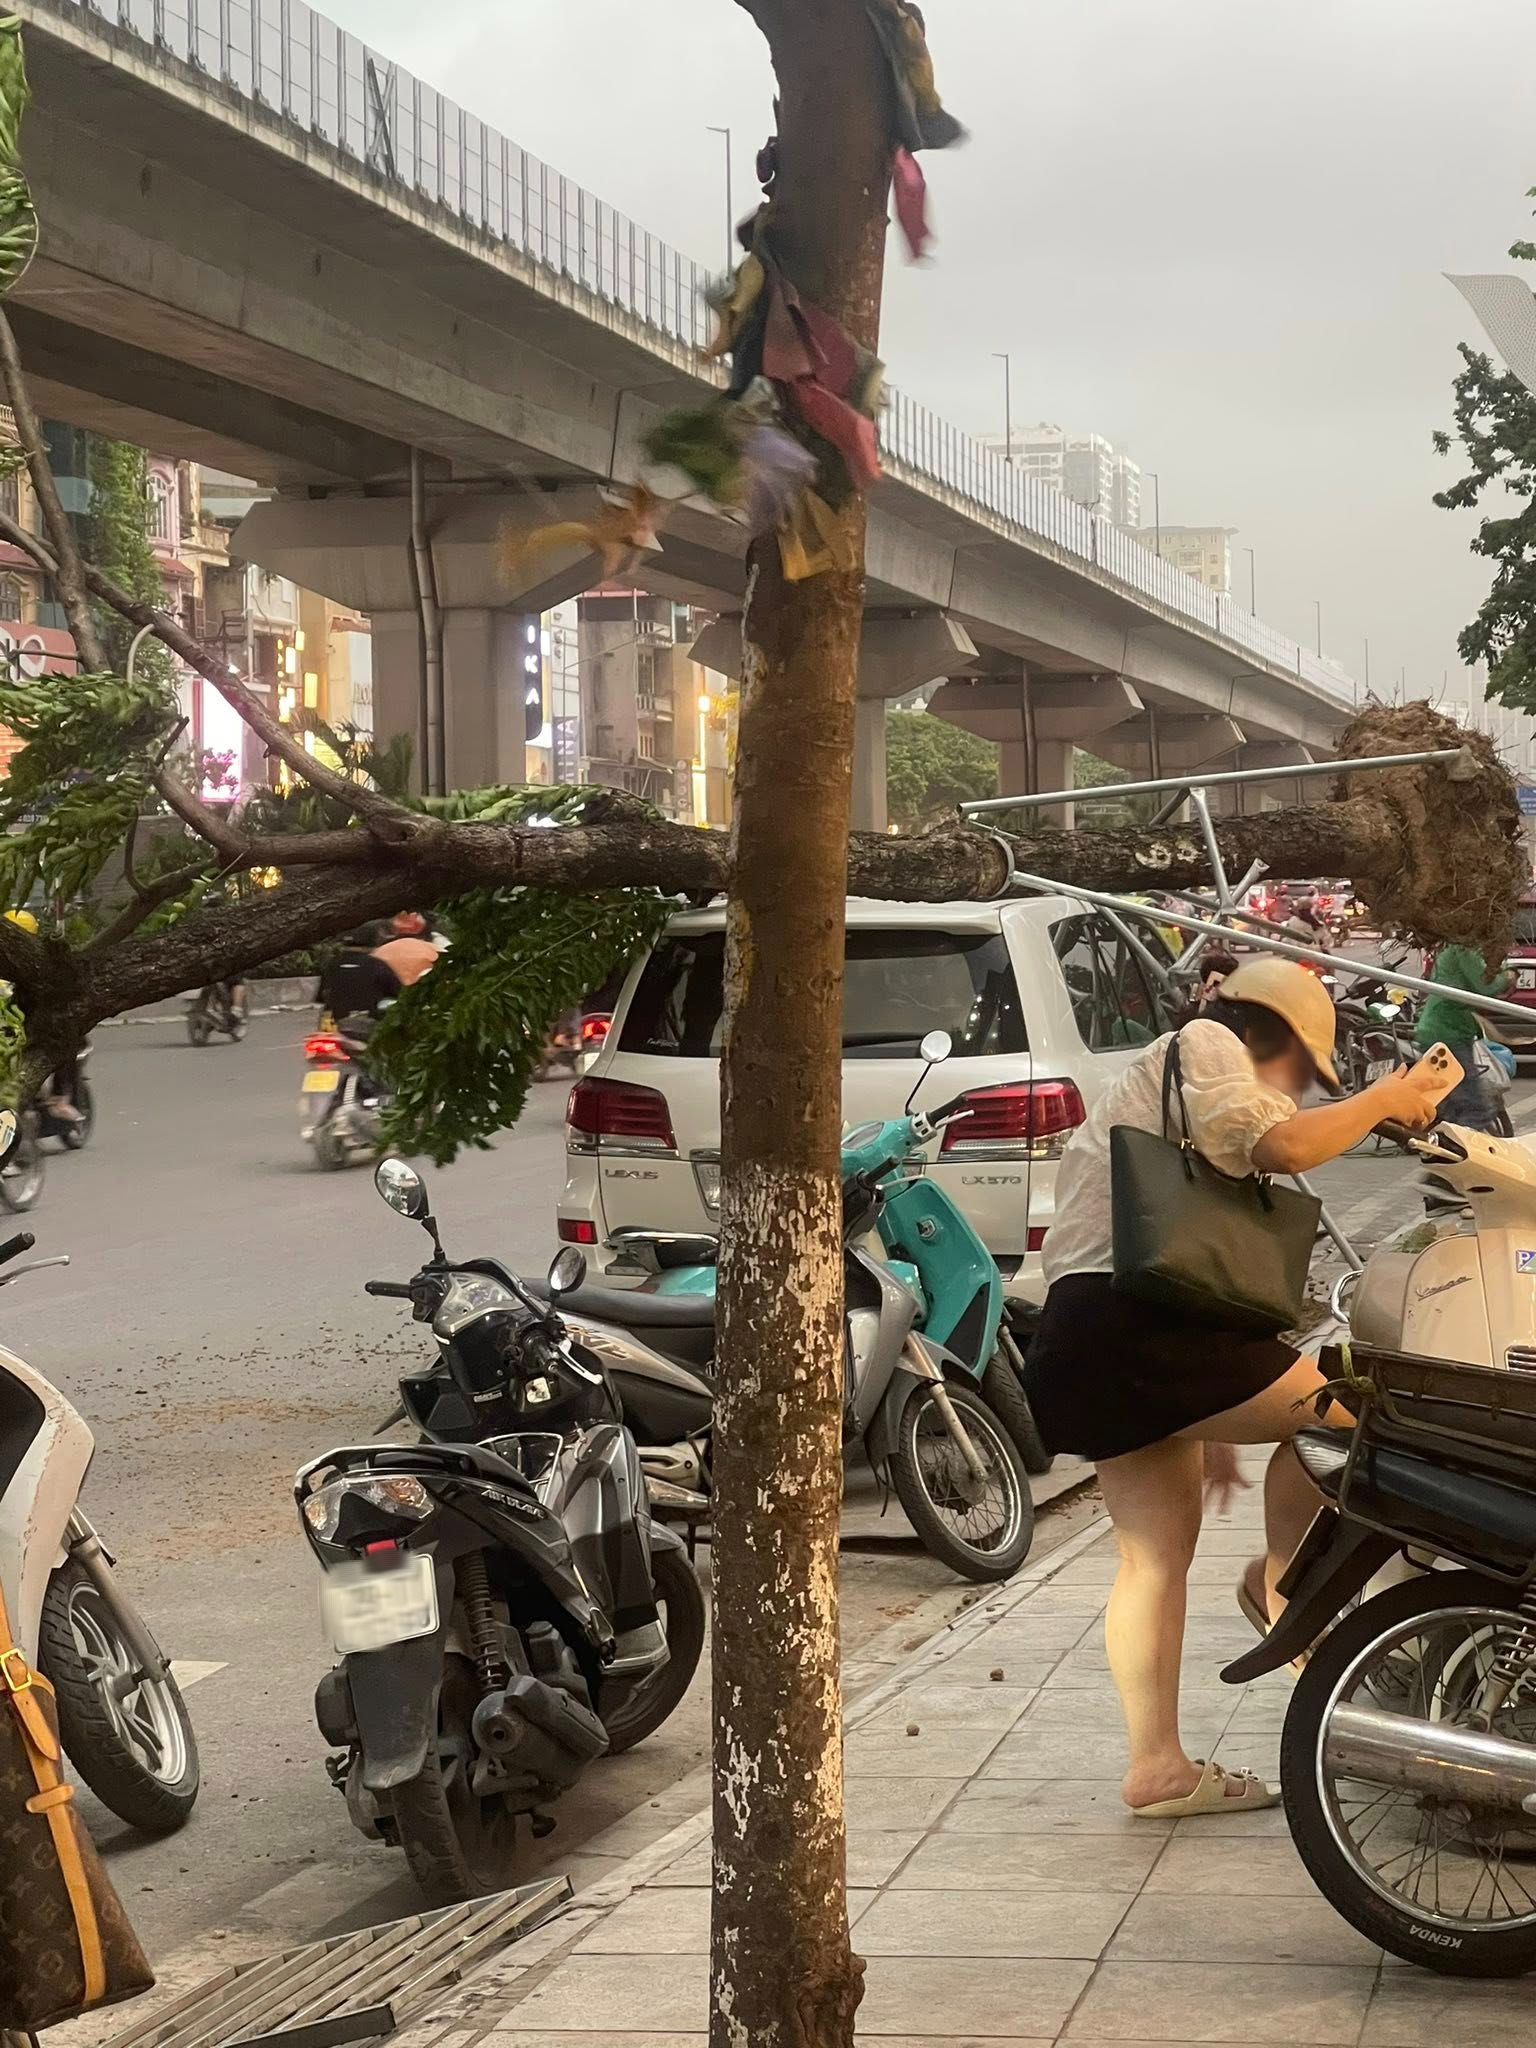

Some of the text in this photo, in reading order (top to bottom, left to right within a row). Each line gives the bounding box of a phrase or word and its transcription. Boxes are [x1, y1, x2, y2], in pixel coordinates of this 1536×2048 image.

[605, 1168, 659, 1180] LEXUS
[962, 1175, 1022, 1185] LX 570
[1409, 1924, 1463, 1949] KENDA
